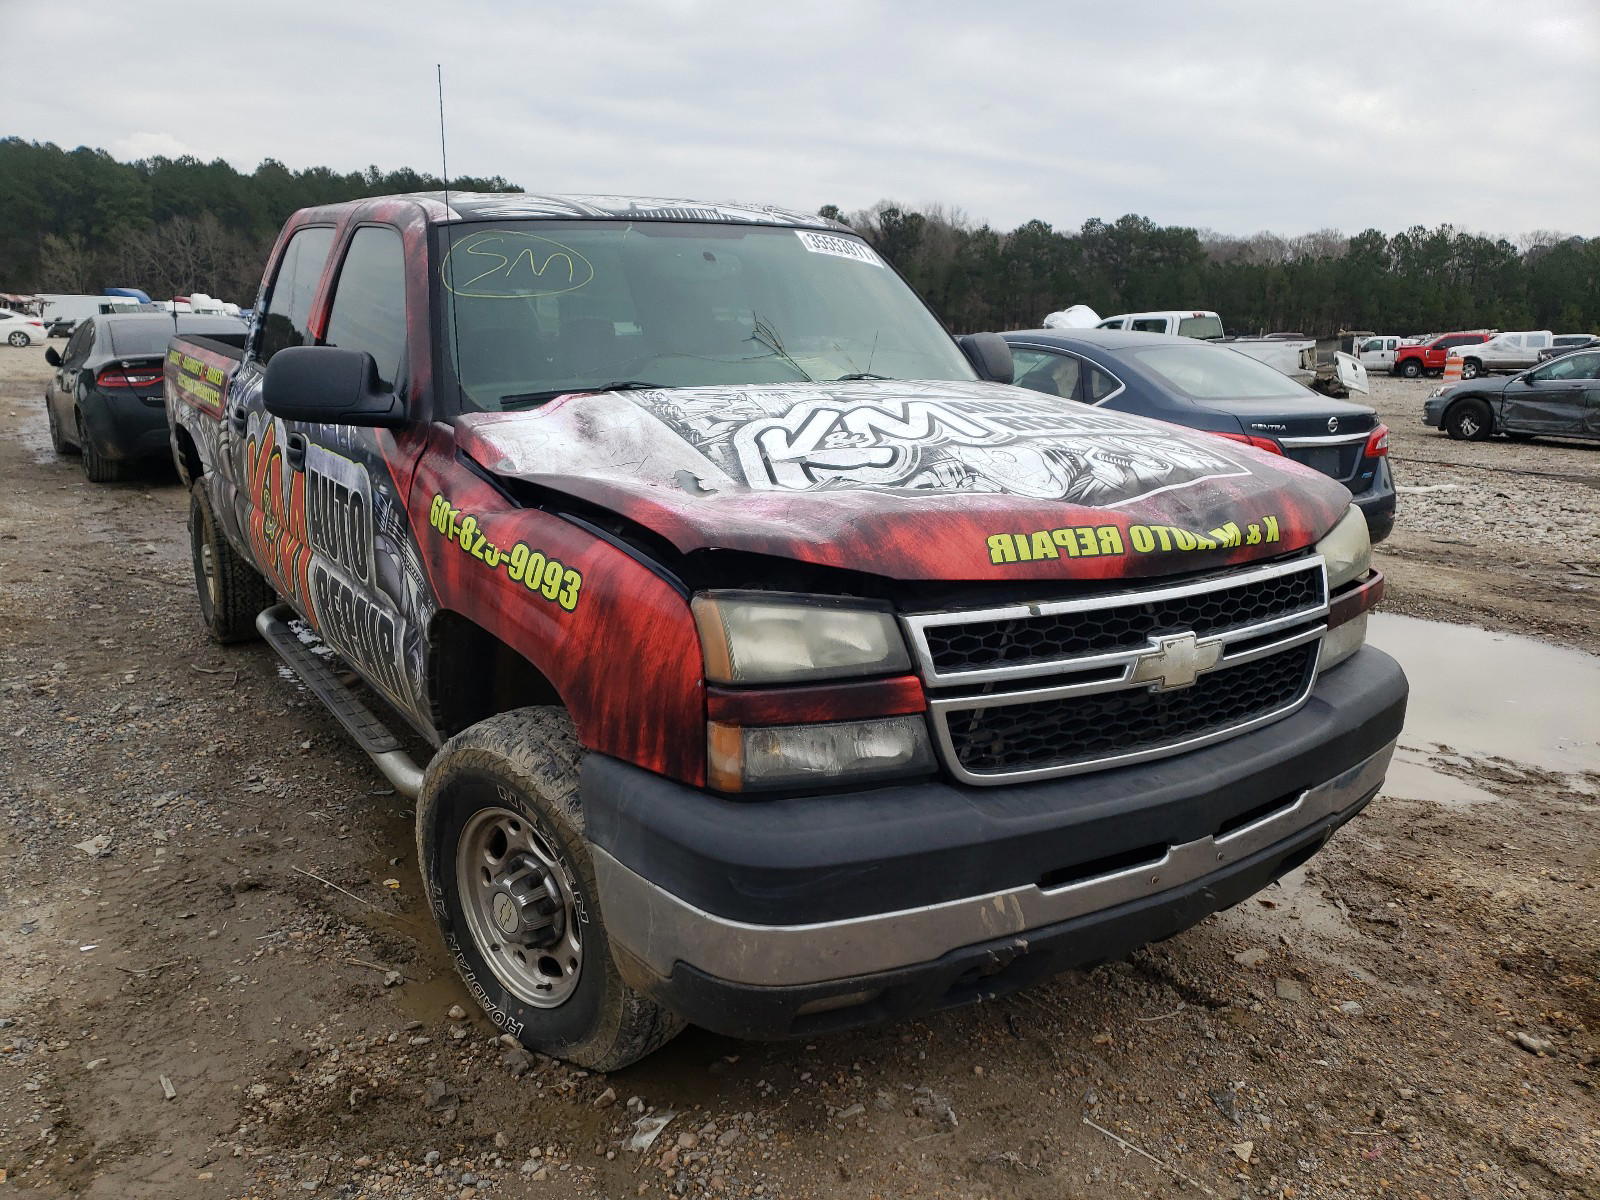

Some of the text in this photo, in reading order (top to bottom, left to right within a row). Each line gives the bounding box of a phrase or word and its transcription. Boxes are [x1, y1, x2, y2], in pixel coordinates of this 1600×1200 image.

[1251, 423, 1287, 431] SENTRA
[308, 467, 372, 584] AUTO
[315, 562, 413, 712] REPAIR
[445, 932, 525, 1038] ROADIAN
